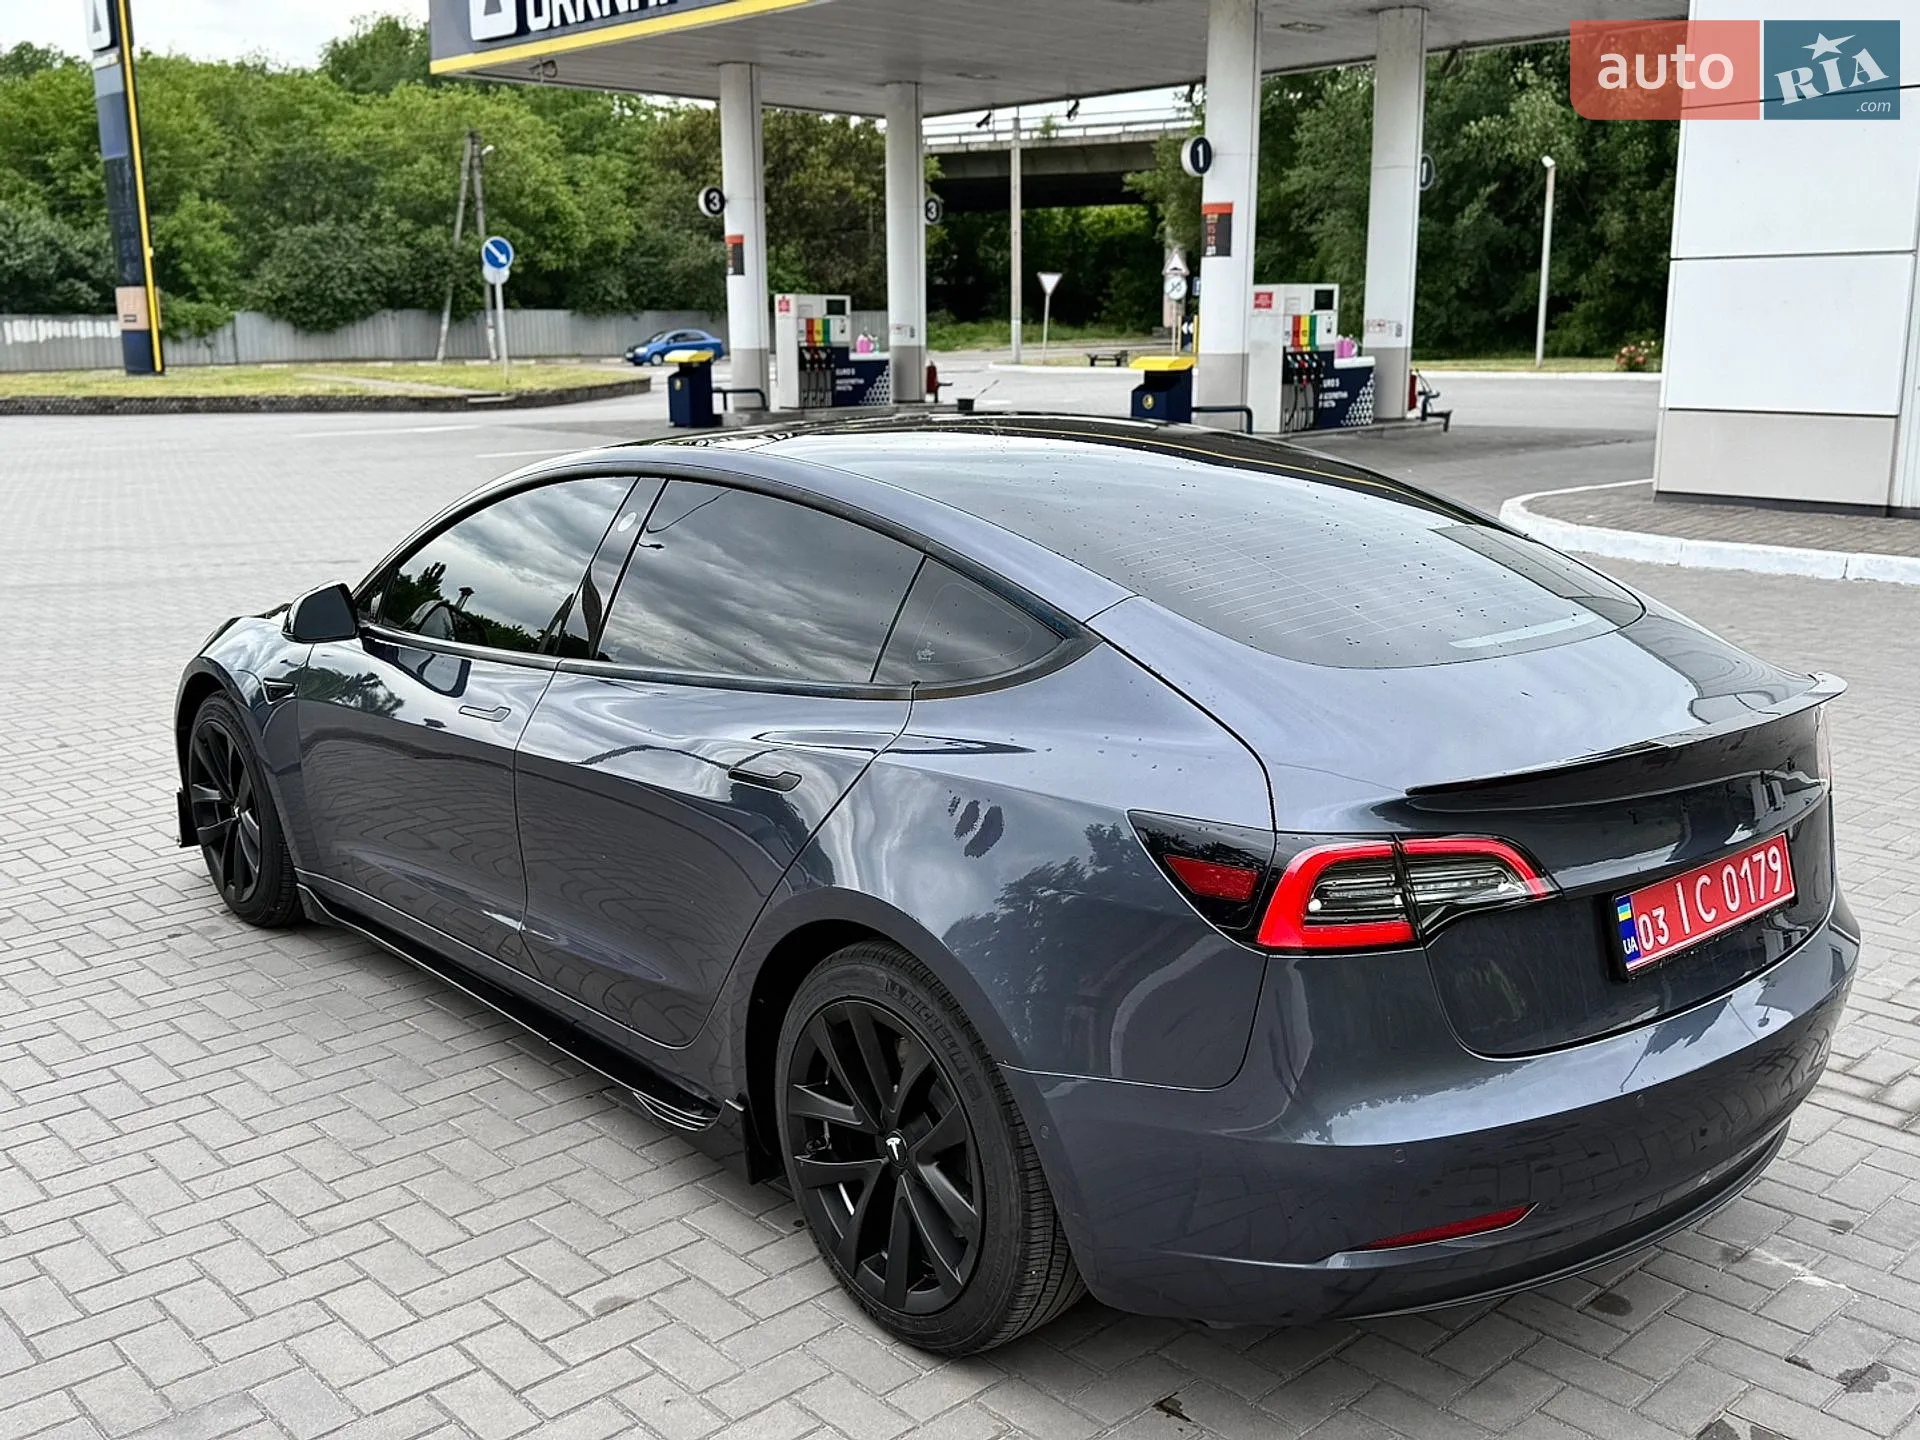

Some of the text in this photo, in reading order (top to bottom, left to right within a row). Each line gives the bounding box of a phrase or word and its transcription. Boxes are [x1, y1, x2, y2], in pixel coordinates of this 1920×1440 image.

[1196, 143, 1204, 169] 1
[708, 190, 721, 212] 3
[927, 200, 937, 220] 3
[1637, 845, 1783, 951] 03 IC 0179
[1622, 936, 1639, 955] UA
